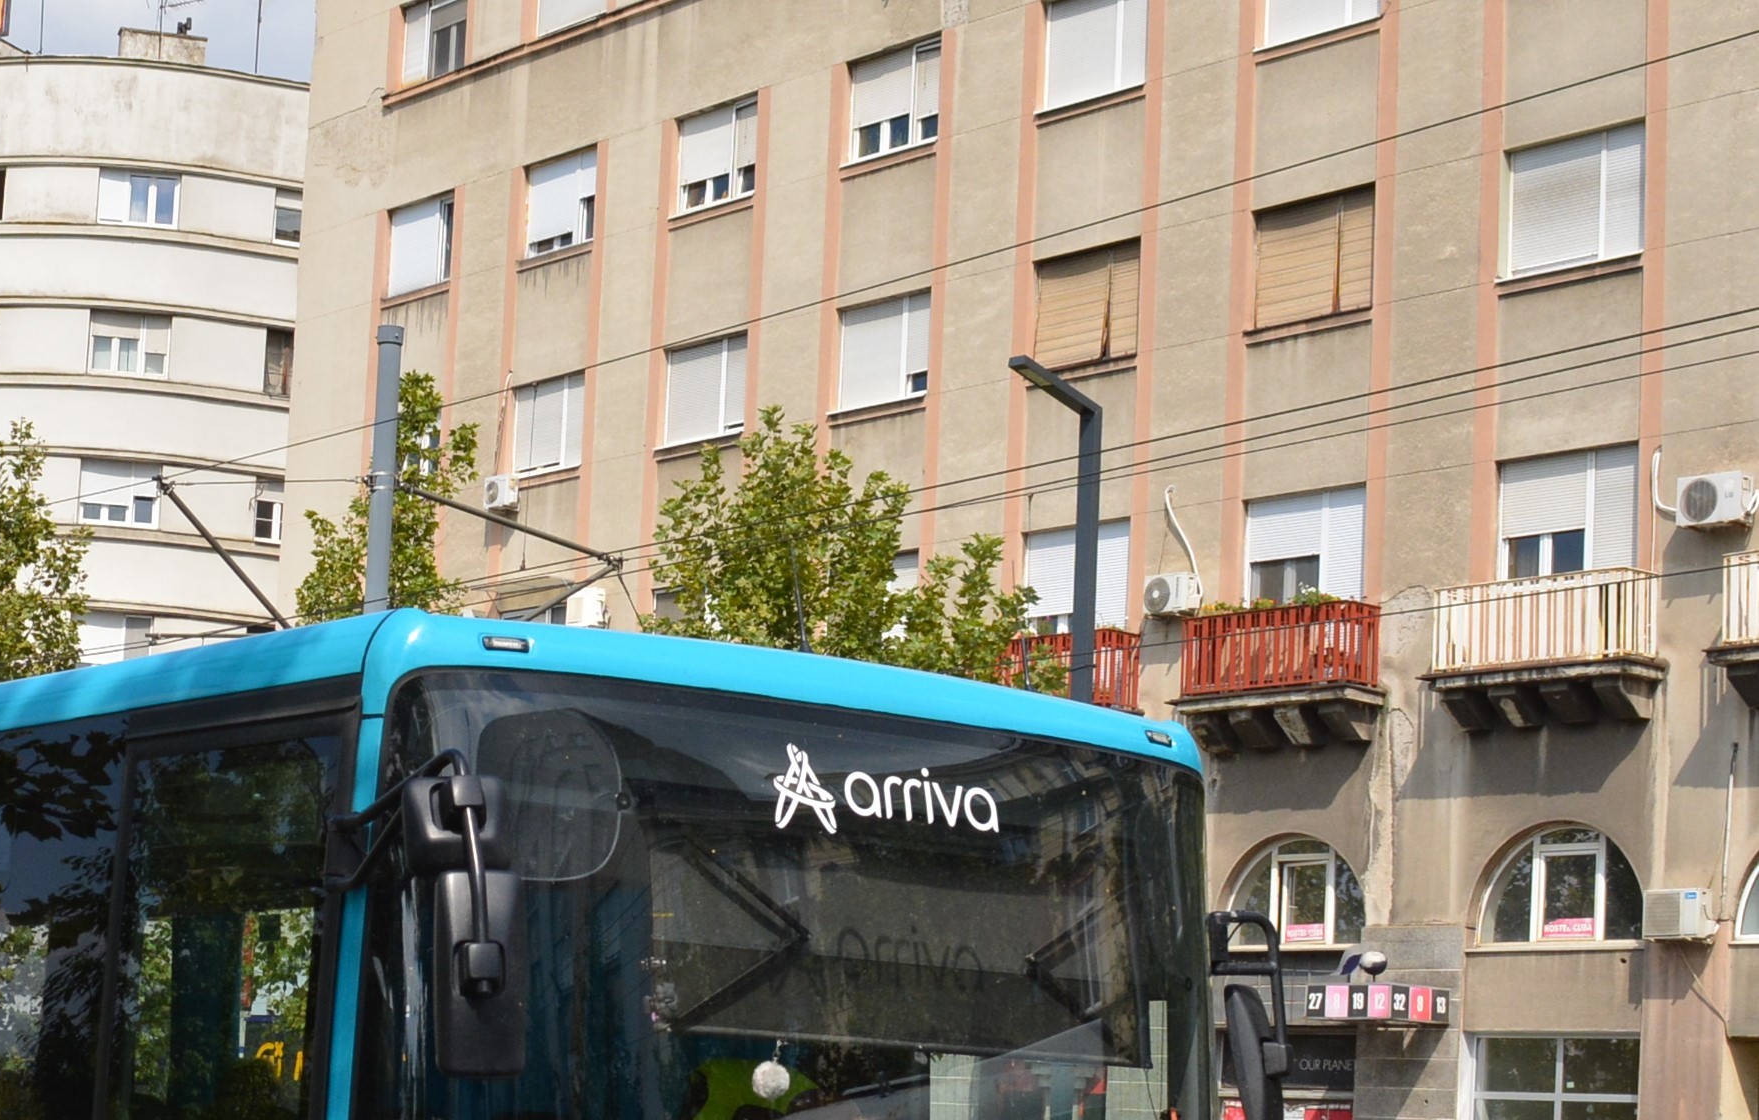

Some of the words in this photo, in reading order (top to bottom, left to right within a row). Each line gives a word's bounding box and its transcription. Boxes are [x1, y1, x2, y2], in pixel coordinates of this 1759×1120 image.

[843, 767, 1000, 834] arriva
[1308, 993, 1324, 1010] 27
[1352, 993, 1364, 1010] 19
[1374, 993, 1386, 1010] 12
[1393, 993, 1406, 1011] 32
[1323, 1058, 1354, 1071] PLANE
